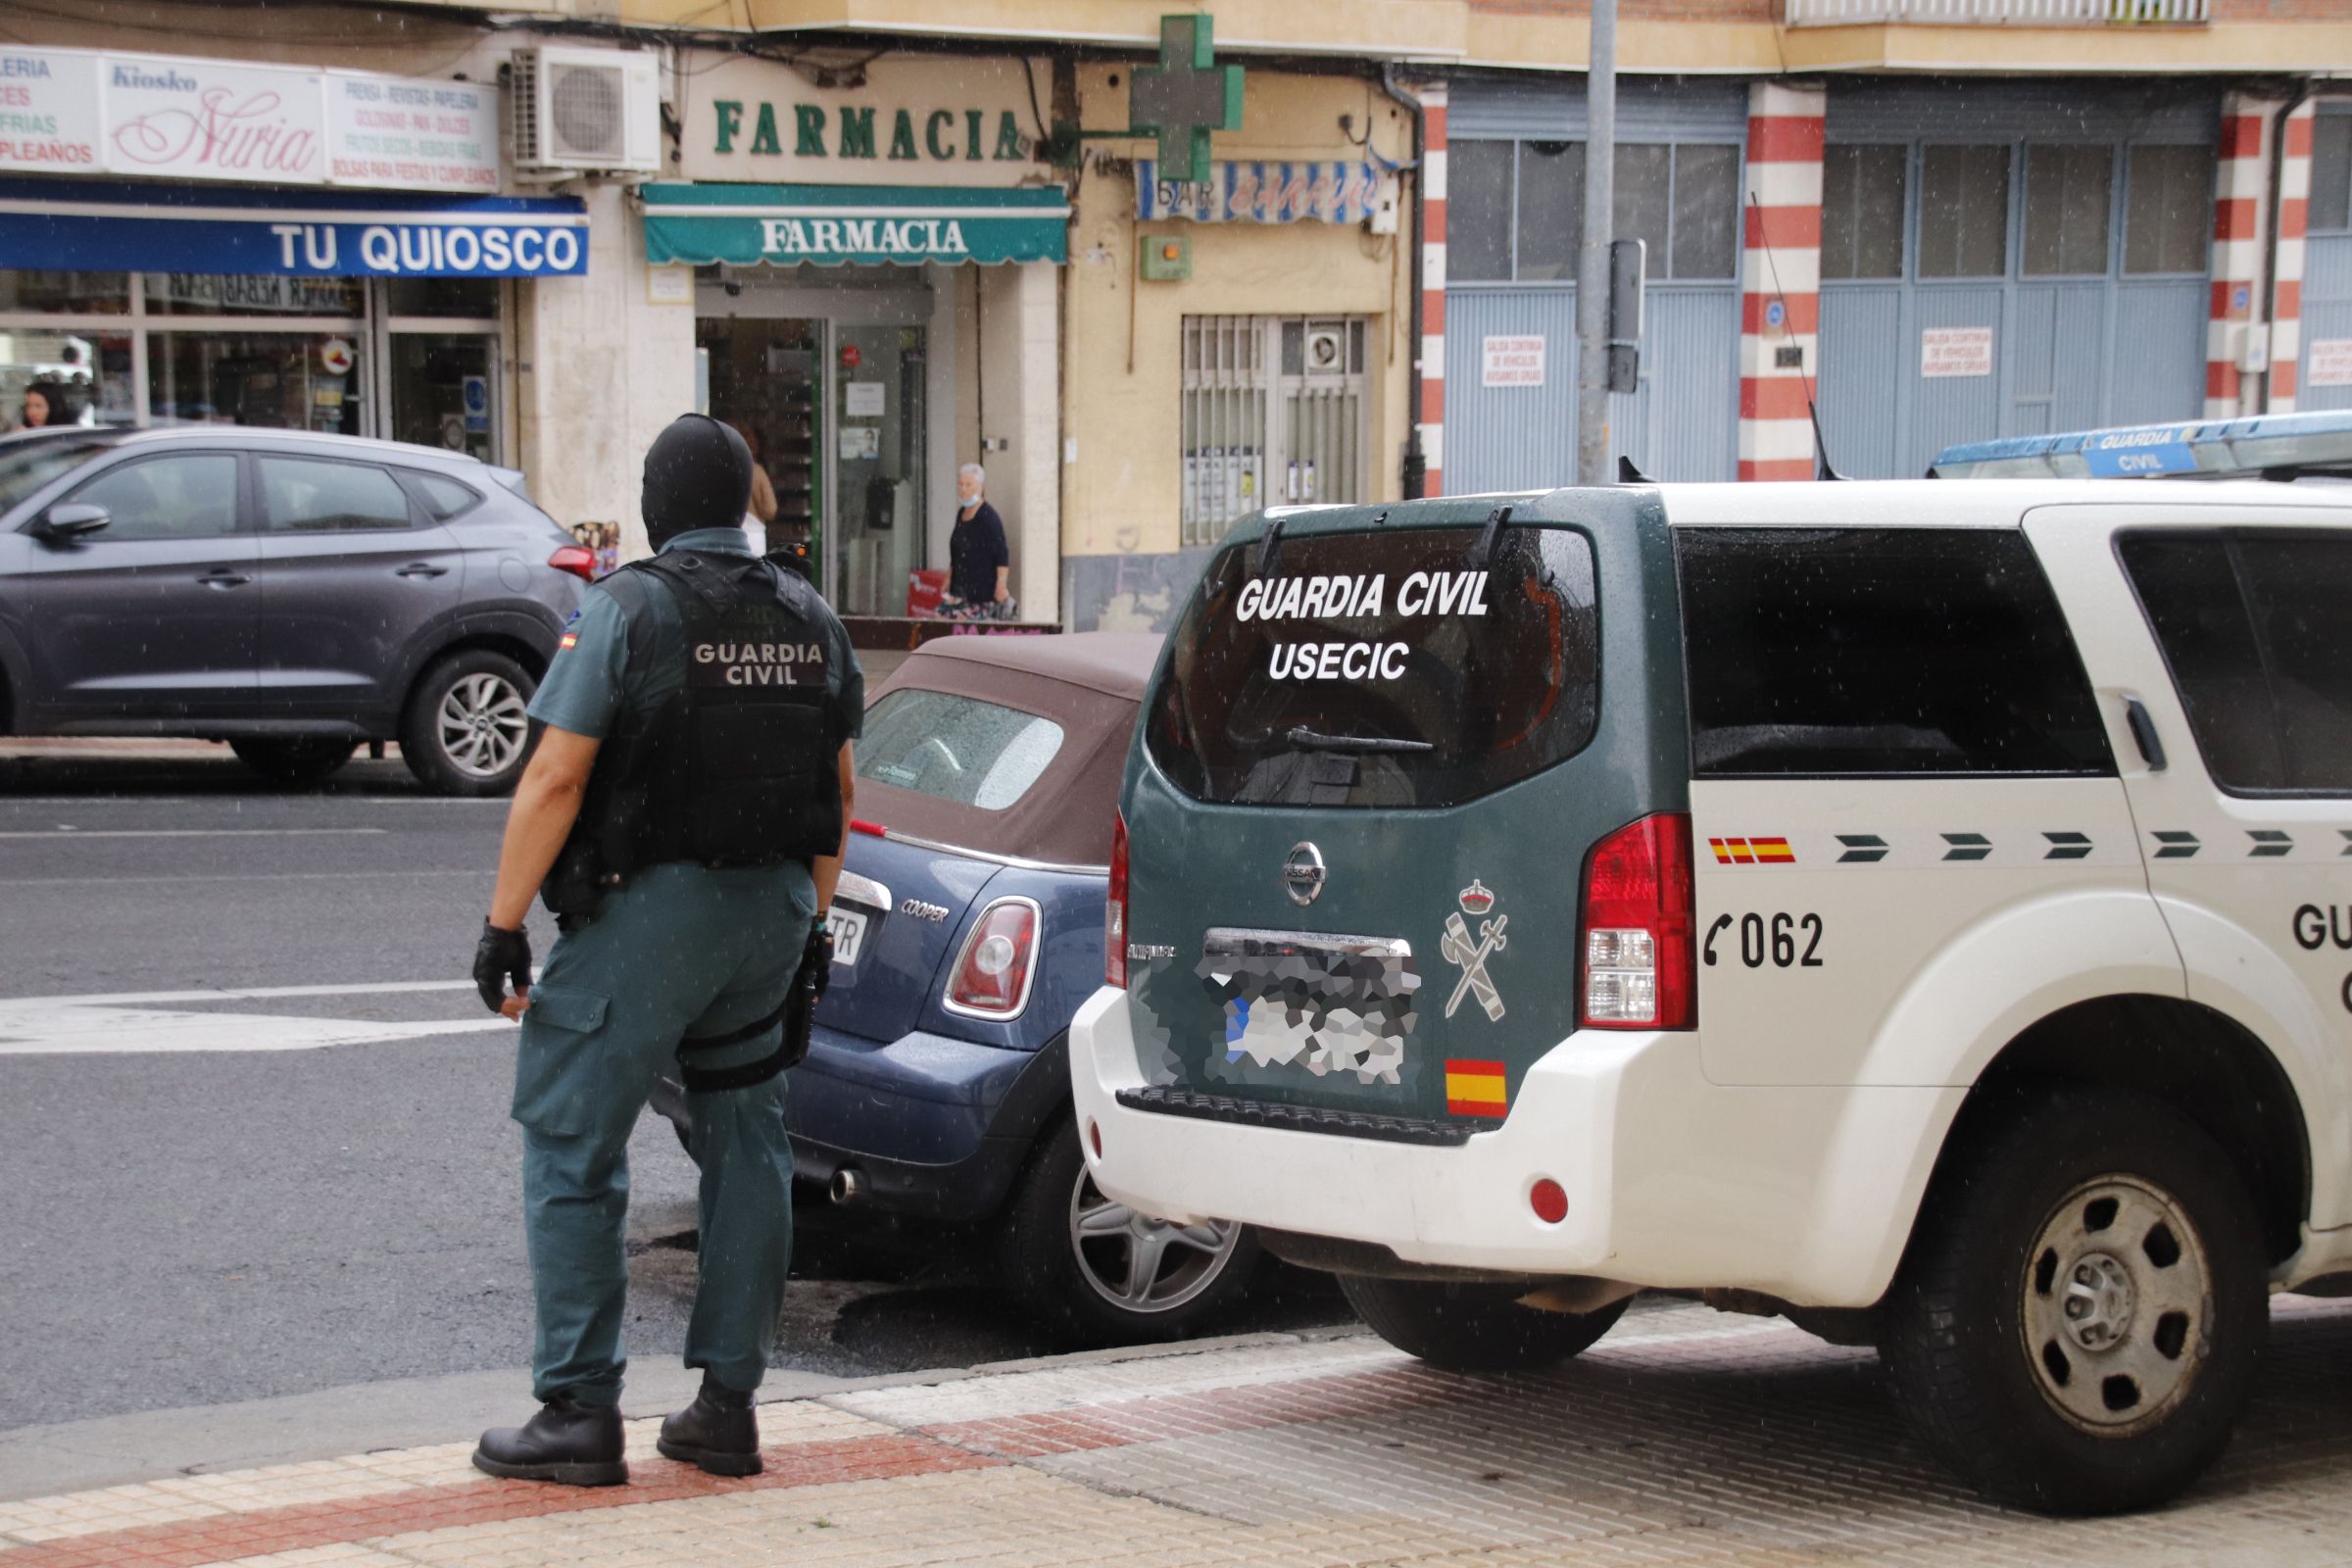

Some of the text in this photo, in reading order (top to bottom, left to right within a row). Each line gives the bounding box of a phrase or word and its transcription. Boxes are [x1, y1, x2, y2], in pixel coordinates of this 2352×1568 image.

[113, 66, 198, 92] Kiosko
[112, 85, 316, 172] Nuria
[713, 101, 1026, 161] FARMACIA
[271, 225, 579, 273] TU QUIOSCO
[760, 219, 968, 254] FARMACIA
[2100, 431, 2173, 450] GUARDIA
[2119, 454, 2163, 470] CIVIL
[1236, 571, 1489, 622] GUARDIA CIVIL
[695, 643, 823, 663] GUARDIA
[1269, 642, 1409, 680] USECIC
[725, 665, 798, 685] CIVIL
[902, 899, 950, 923] COOPER
[1740, 911, 1823, 968] 062
